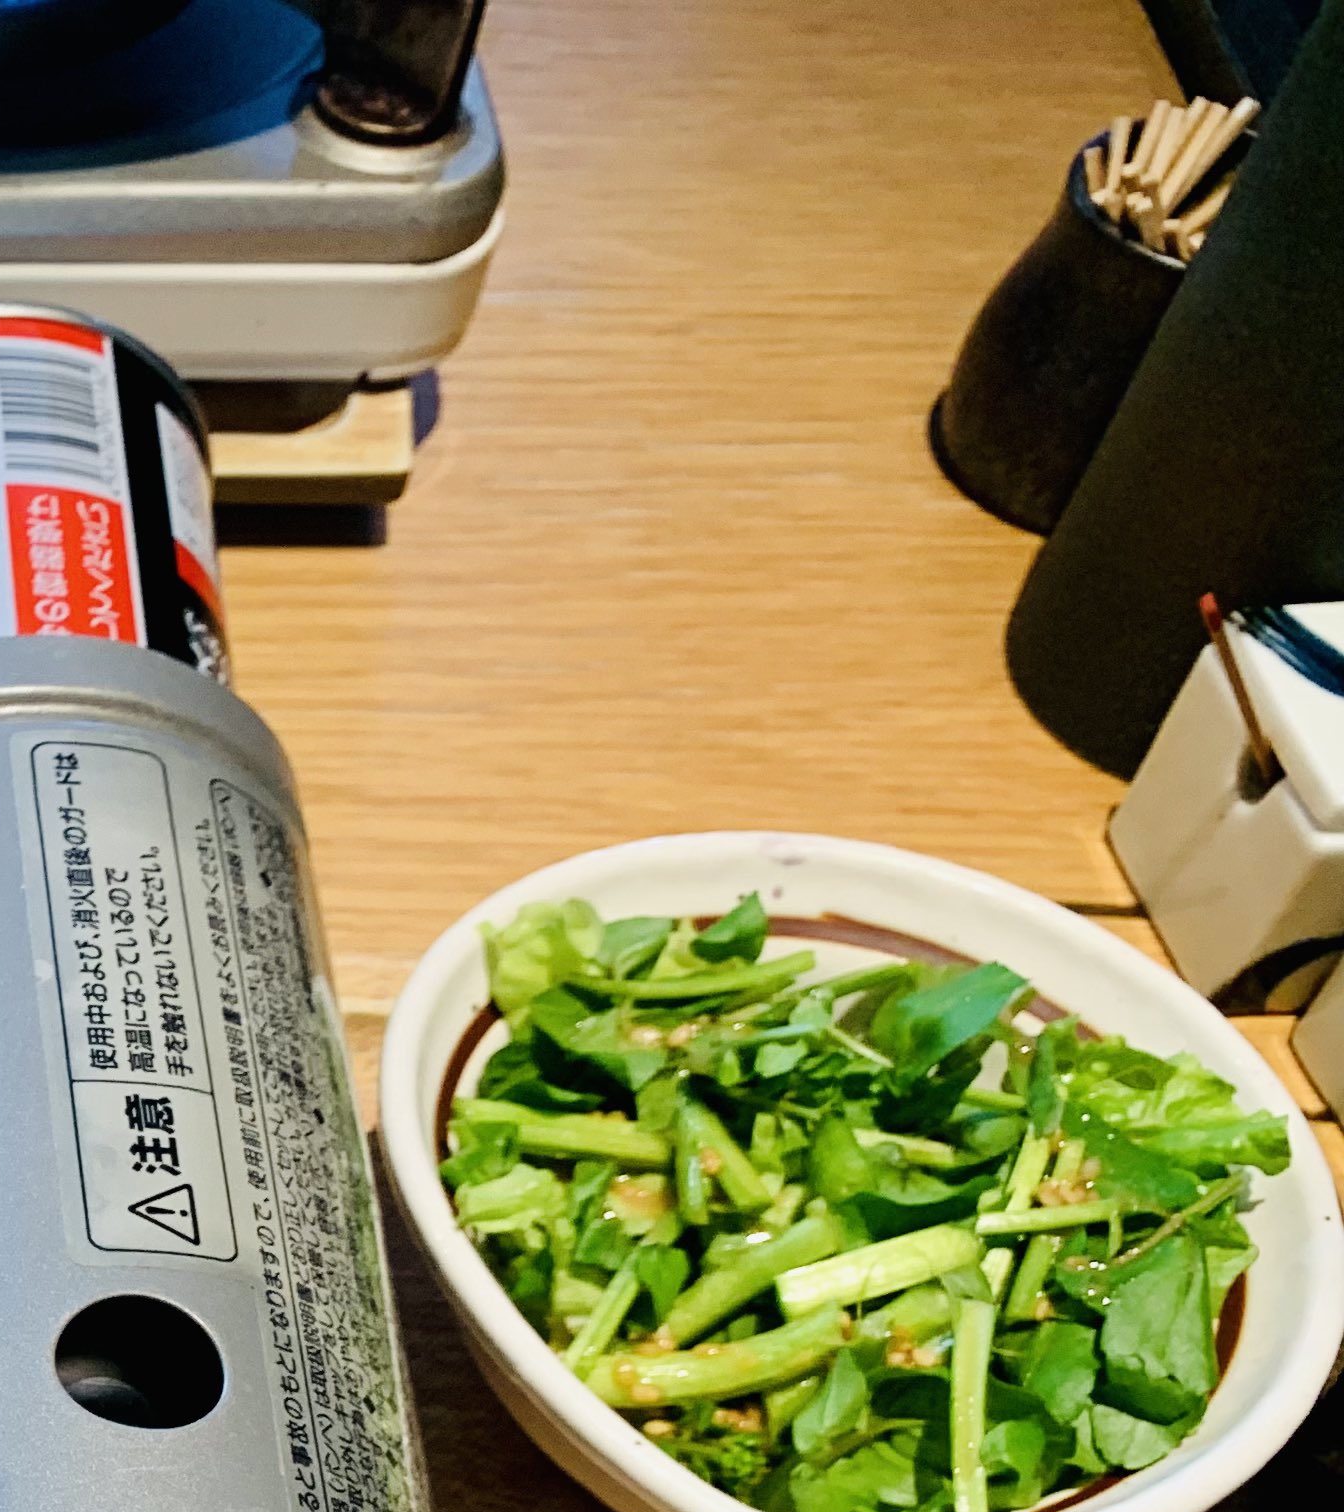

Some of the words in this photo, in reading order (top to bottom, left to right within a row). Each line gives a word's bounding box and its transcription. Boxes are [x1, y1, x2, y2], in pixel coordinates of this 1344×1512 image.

[53, 751, 120, 1071] 使用中および、消火直後のガードは
[105, 866, 158, 1075] 高温になっているので
[140, 845, 194, 1078] 手を触れないでください。
[124, 1093, 183, 1176] 注意
